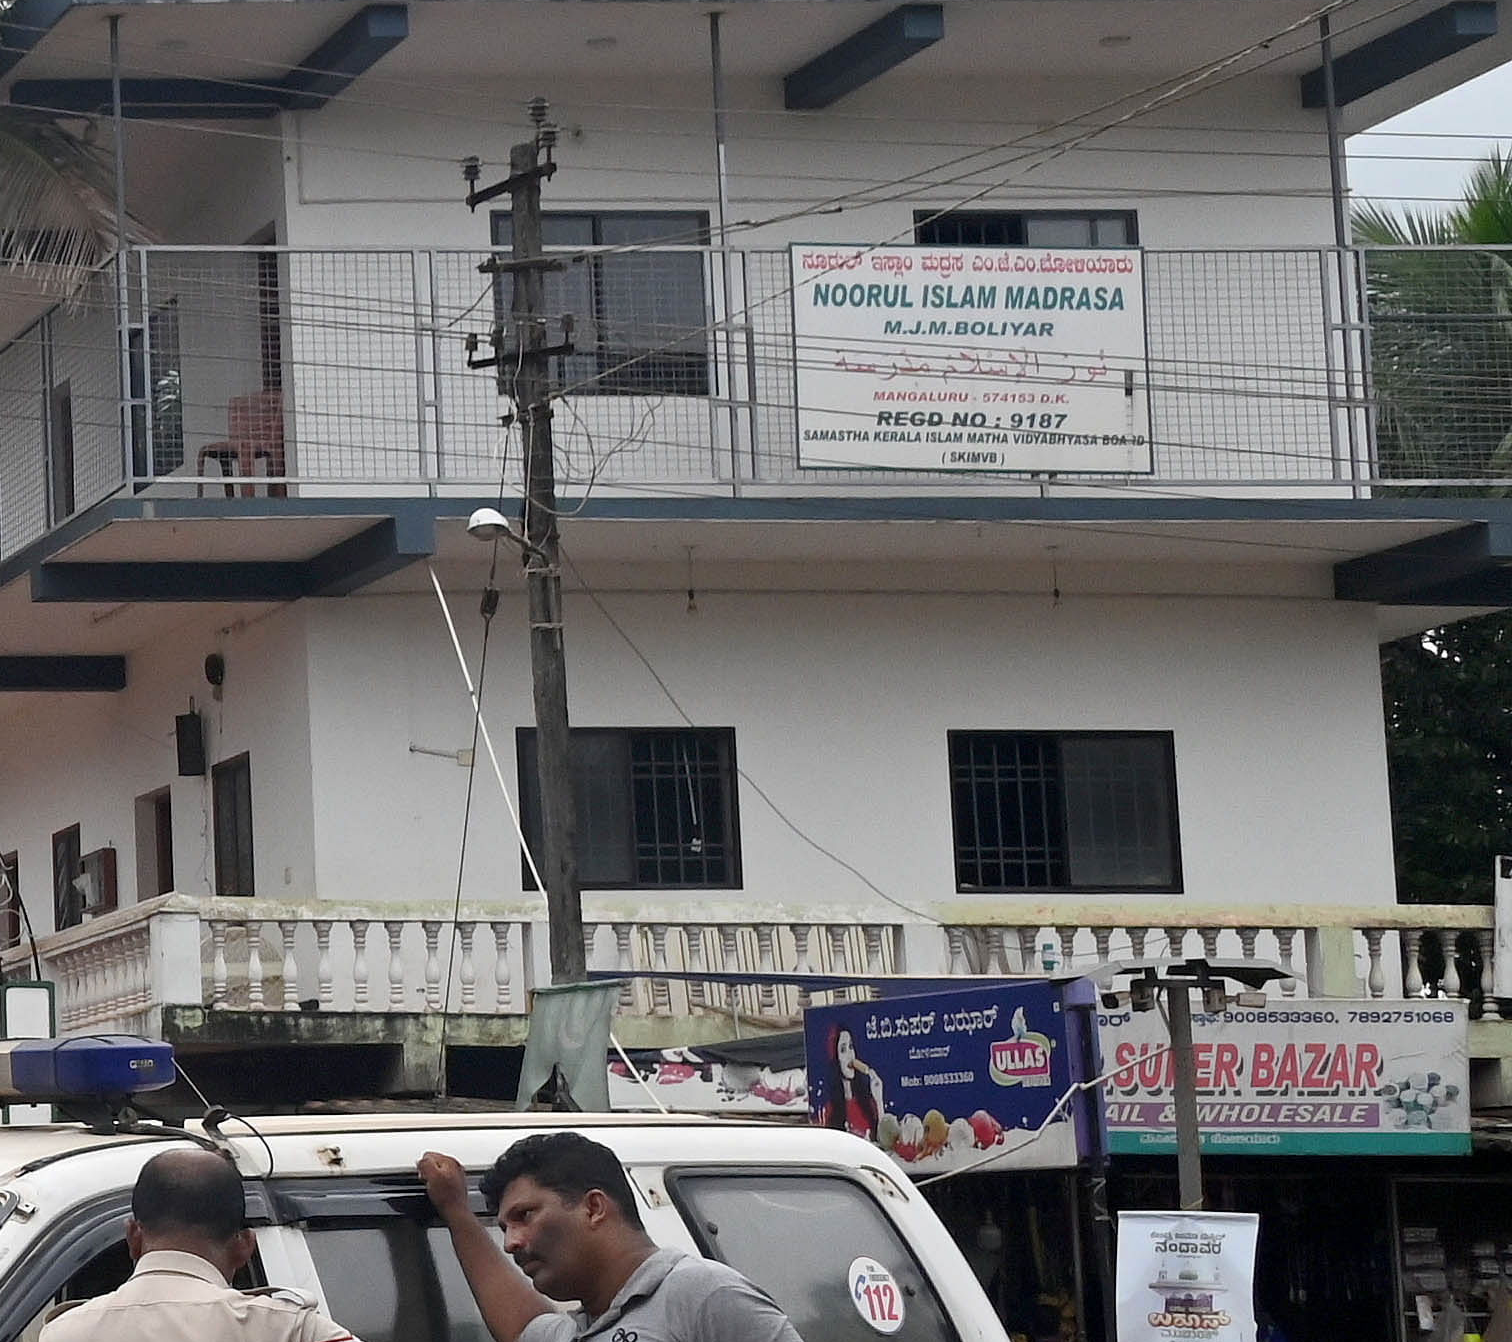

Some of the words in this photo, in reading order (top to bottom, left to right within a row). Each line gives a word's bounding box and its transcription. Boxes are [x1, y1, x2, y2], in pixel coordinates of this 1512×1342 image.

[812, 283, 914, 308] NOORUL
[921, 284, 997, 310] ISLAM
[1004, 285, 1125, 311] MADRASA
[883, 319, 1055, 337] M.J.M.BOLIYAR
[873, 389, 970, 403] MANGALURU
[981, 391, 1037, 404] 574153
[1039, 392, 1070, 404] D.K.
[876, 410, 943, 428] REGD
[951, 411, 987, 428] NO
[1010, 413, 1068, 429] 9187
[802, 429, 871, 443] SAMASTHA
[873, 430, 923, 443] KERALA
[925, 431, 964, 444] ISLAM
[966, 432, 1008, 445] MATHA
[1013, 433, 1098, 446] VIDYABHYASA
[949, 451, 998, 464] SKIMVB
[1348, 1010, 1455, 1024] 7892751068
[995, 1048, 1046, 1072] ULLAS
[1113, 1042, 1243, 1091] SUER
[1251, 1042, 1384, 1091] BAZAR
[1197, 1103, 1370, 1123] WHOLESALE
[1154, 1240, 1223, 1255] ನಂದಾವರ
[863, 1284, 899, 1321] 112
